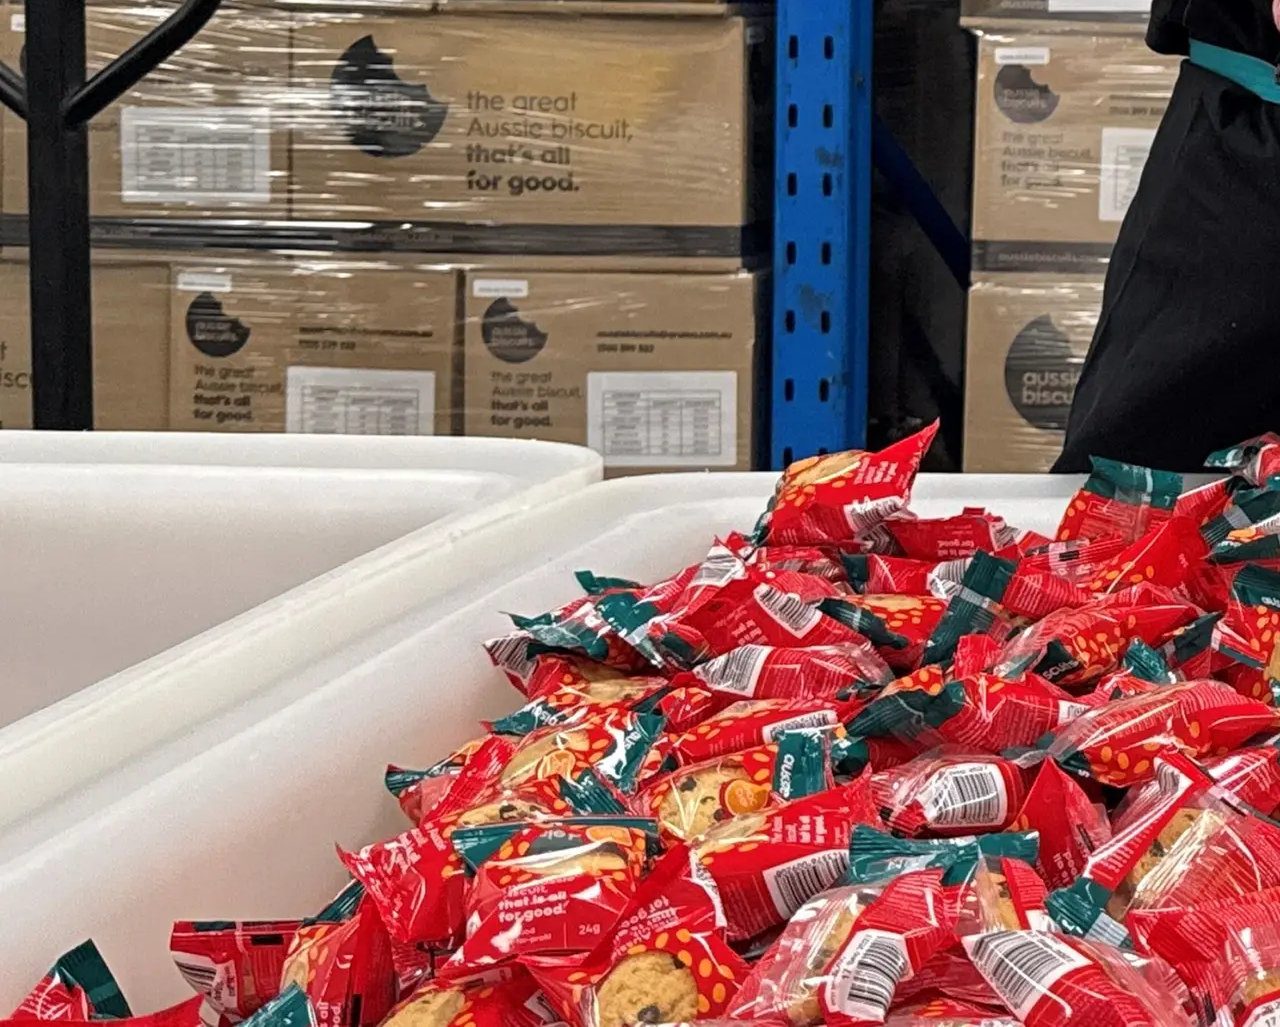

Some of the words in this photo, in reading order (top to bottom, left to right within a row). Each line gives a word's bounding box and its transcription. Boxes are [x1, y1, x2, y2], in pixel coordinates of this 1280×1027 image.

[466, 91, 505, 111] the
[512, 91, 577, 119] great
[466, 117, 543, 138] Aussie
[465, 143, 533, 165] that's
[540, 145, 571, 165] all
[466, 170, 500, 192] for
[508, 171, 580, 196] good.
[531, 400, 549, 411] all
[491, 414, 512, 426] for
